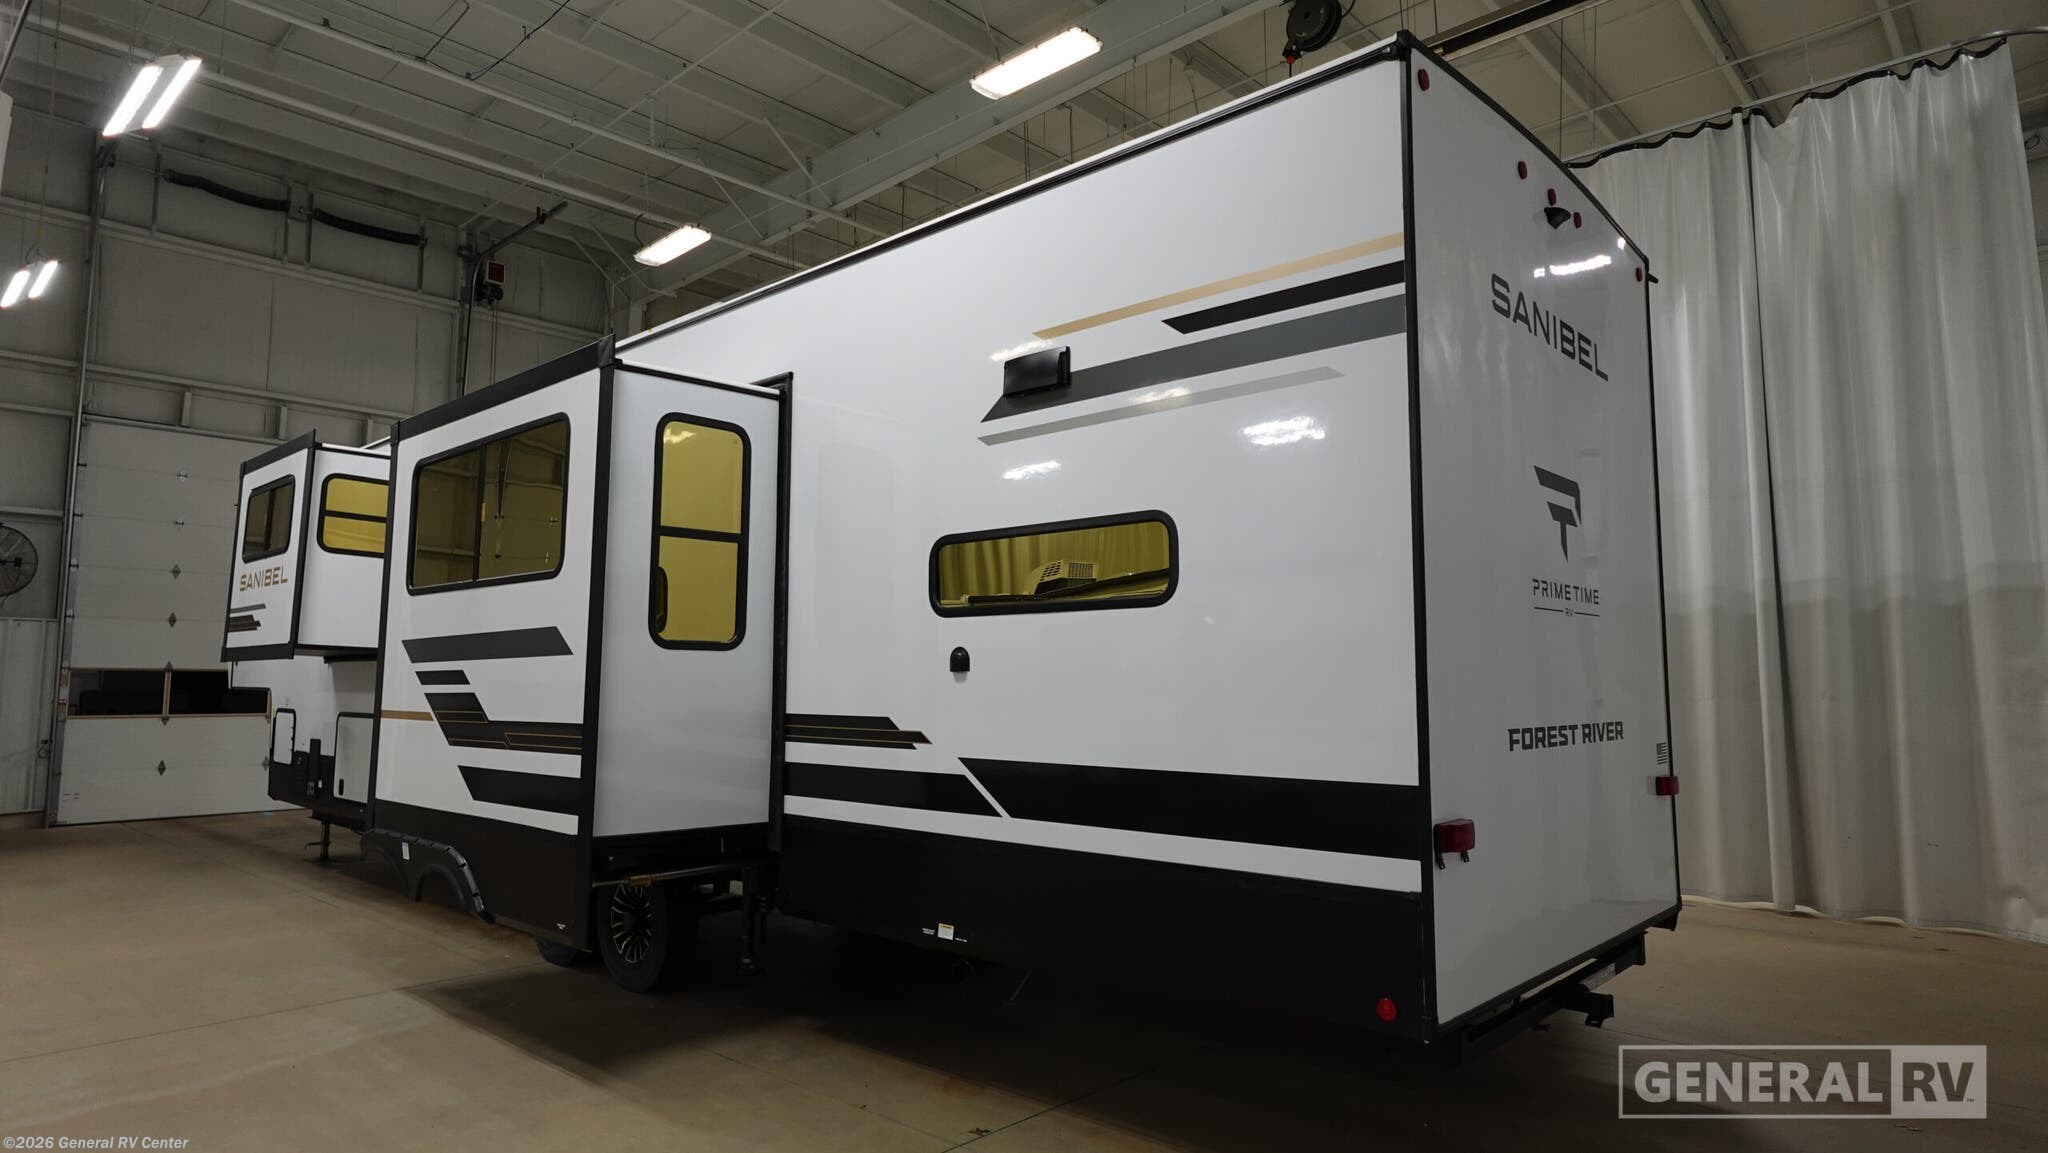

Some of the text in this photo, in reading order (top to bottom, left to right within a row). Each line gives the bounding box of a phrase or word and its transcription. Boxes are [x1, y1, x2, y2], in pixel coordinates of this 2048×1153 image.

[1491, 272, 1609, 382] SANIBEL
[239, 564, 289, 592] SANIBEL
[1532, 578, 1600, 605] PRIMETIME
[1508, 721, 1625, 751] FOREST RIVER
